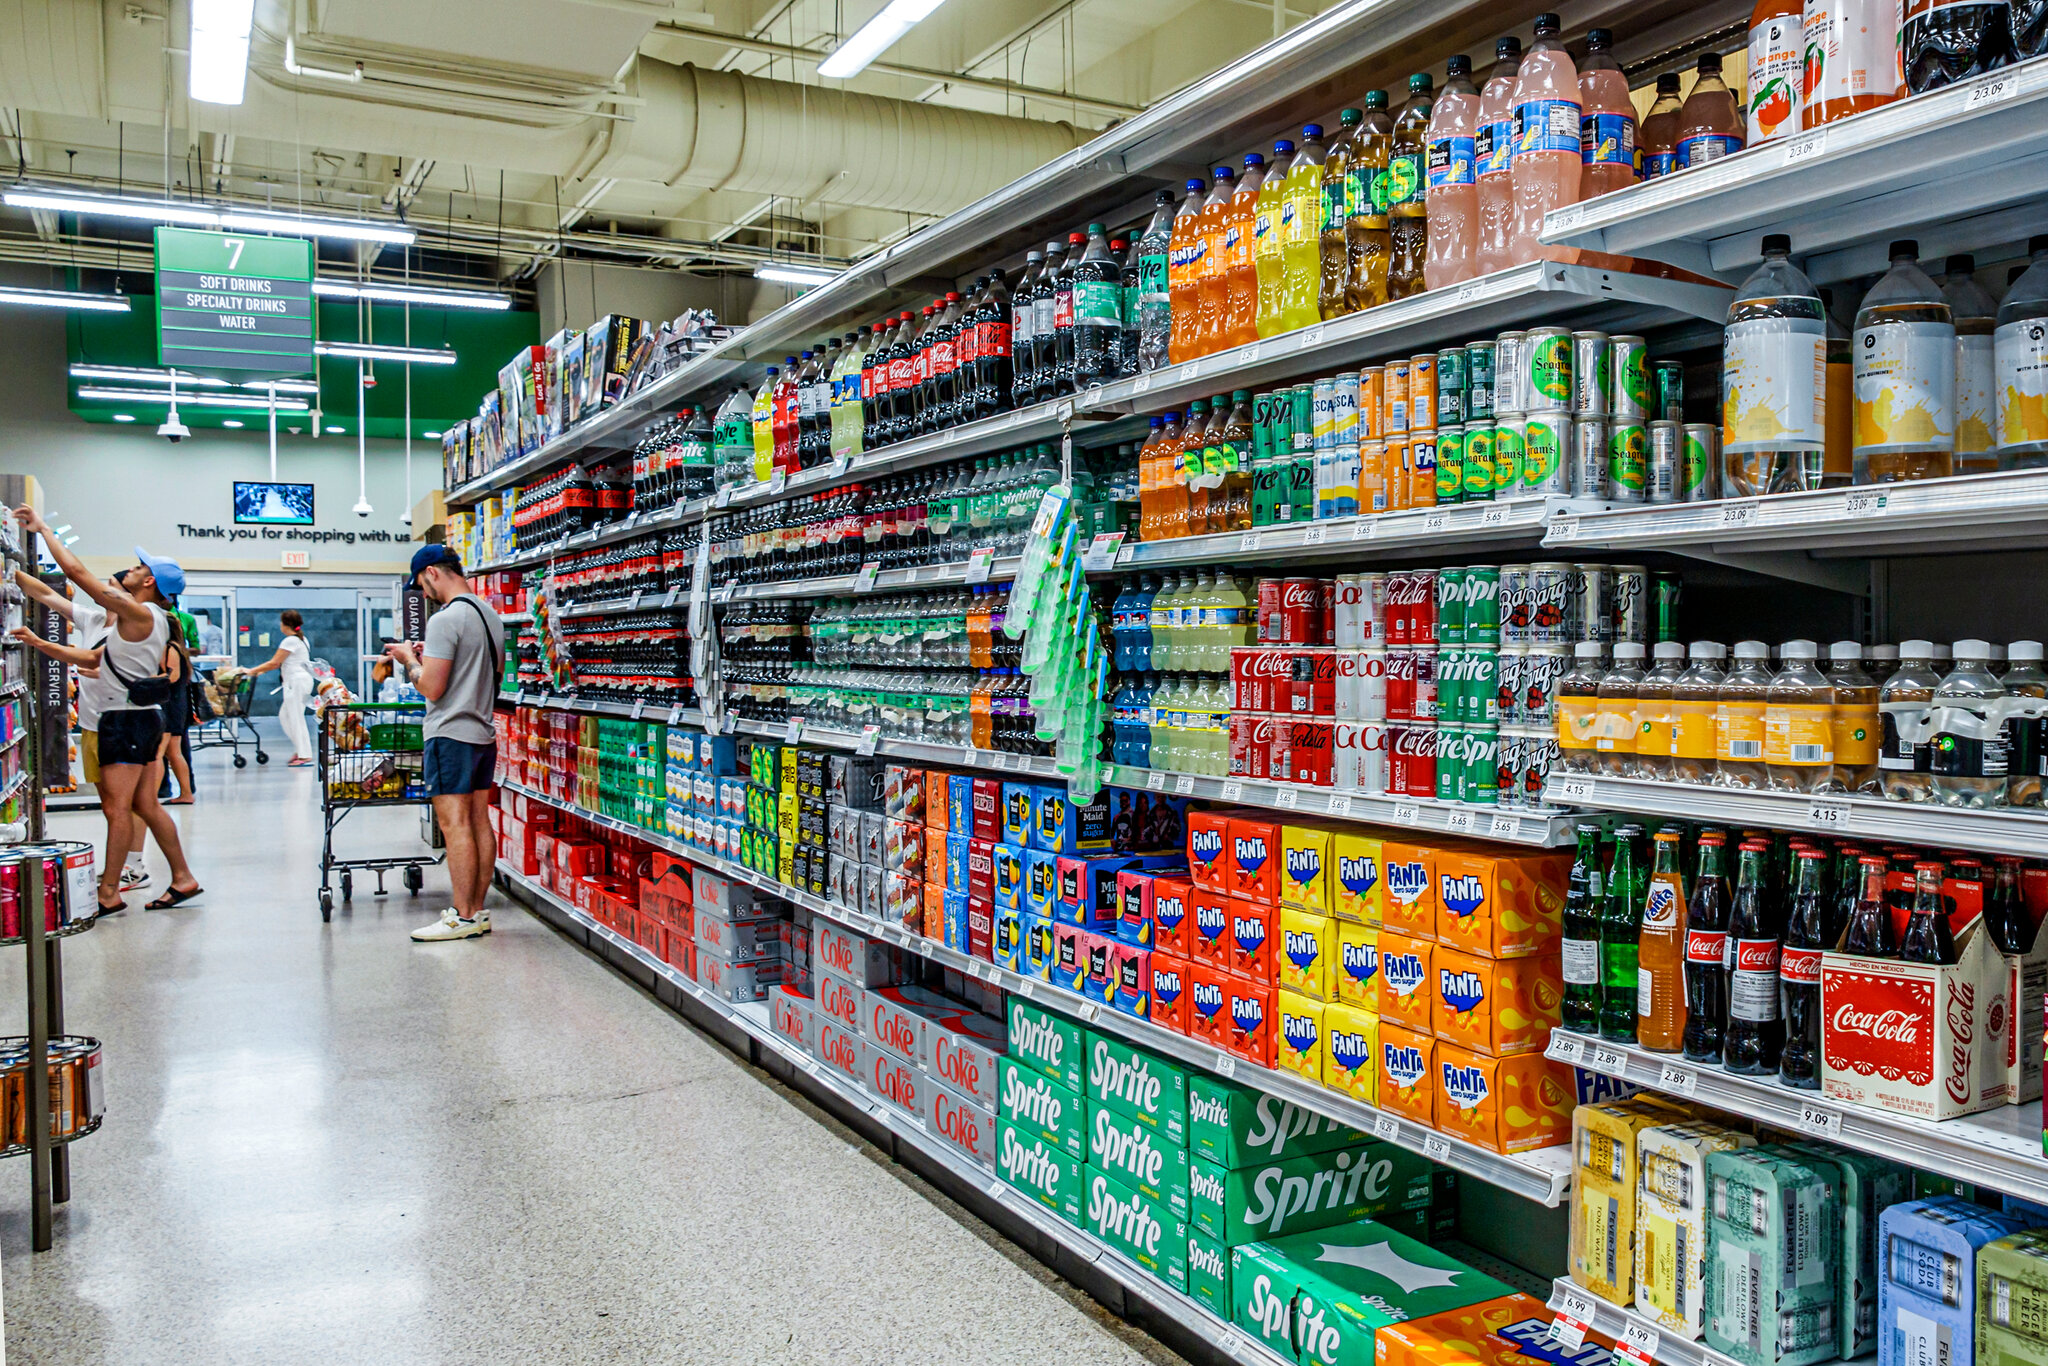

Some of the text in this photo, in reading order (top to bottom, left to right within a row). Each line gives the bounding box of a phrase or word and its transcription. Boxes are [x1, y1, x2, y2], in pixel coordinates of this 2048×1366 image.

[1804, 11, 1827, 29] range
[1757, 50, 1797, 66] orange
[1973, 82, 2004, 101] 2/3.09
[1789, 141, 1814, 159] 2/3.09
[224, 239, 245, 270] 7
[200, 275, 272, 294] SOFT DRINKS
[186, 294, 287, 313] SPECIALTY DRINKS
[219, 315, 256, 330] WATER
[1304, 332, 1317, 343] 2.29
[1241, 350, 1253, 361] 2.29
[1868, 359, 1902, 369] water
[534, 362, 542, 373] Go
[753, 409, 771, 423] ANTA
[1526, 443, 1556, 456] gram's
[1846, 499, 1868, 512] 2/3.09
[1427, 518, 1443, 528] 5.65
[1486, 512, 1502, 522] 5.65
[1724, 509, 1747, 522] 2/3.09
[177, 524, 411, 544] Thank you for shopping with us
[1307, 530, 1321, 540] 5.65
[1356, 525, 1371, 535] 5.65
[1243, 536, 1256, 546] 5.65
[286, 552, 306, 566] EXIT
[48, 659, 60, 707] SERVICE
[1178, 778, 1189, 788] 5.65
[1225, 786, 1236, 795] 5.65
[1401, 779, 1406, 792] ME
[1566, 785, 1584, 796] 4.15
[1279, 793, 1292, 803] 5.65
[1331, 800, 1345, 810] 5.65
[1083, 811, 1104, 821] Maid
[1396, 809, 1412, 819] 5.65
[1451, 815, 1467, 826] 5.65
[1813, 808, 1838, 822] 4.15
[1082, 829, 1105, 838] sugar
[1494, 821, 1511, 832] 5.65
[1192, 830, 1223, 852] FANTA
[1235, 838, 1267, 860] FANTA
[1287, 849, 1320, 871] FANTA
[1340, 857, 1378, 881] FANTA
[1387, 862, 1428, 887] FANTA
[1405, 887, 1420, 896] sugar
[1441, 874, 1484, 901] FANTA
[1125, 893, 1140, 905] Minute
[1127, 903, 1139, 913] Maid
[1156, 897, 1185, 918] FANTA
[1197, 906, 1226, 928] FANTA
[1234, 917, 1265, 940] FANTA
[820, 928, 853, 977] Coke
[1285, 931, 1319, 956] FANTA
[1343, 943, 1378, 968] FANTA
[1122, 964, 1137, 978] Minute
[1384, 953, 1424, 979] FANTA
[1849, 961, 1870, 970] HECHO
[1871, 963, 1880, 971] EN
[1124, 974, 1136, 986] Maid
[1154, 970, 1182, 993] FANTA
[1390, 977, 1417, 987] zero sugar
[1440, 969, 1484, 998] FANTA
[821, 977, 856, 1025] Coke
[1193, 982, 1223, 1006] FANTA
[1232, 996, 1263, 1021] FANTA
[874, 1004, 914, 1057] Coke
[1283, 1014, 1318, 1040] FANTA
[1833, 1002, 1923, 1044] Coca-Cola
[1010, 1003, 1063, 1066] Sprite
[1945, 974, 1975, 1105] Coca-Cola
[821, 1025, 855, 1076] Coke
[963, 1045, 976, 1063] Diet
[1331, 1030, 1369, 1060] FANTA
[1556, 1039, 1574, 1053] 2.89
[936, 1036, 979, 1095] Coke
[1384, 1044, 1425, 1072] FANTA
[1598, 1051, 1617, 1065] 2.89
[875, 1056, 915, 1111] Coke
[1090, 1040, 1161, 1113] Sprite
[1174, 1075, 1182, 1085] 12
[1391, 1069, 1417, 1080] zero sugar
[1442, 1063, 1488, 1094] FANTA
[1664, 1070, 1686, 1085] 2.89
[1003, 1065, 1062, 1132] Sprite
[1450, 1090, 1479, 1101] zero sugar
[963, 1104, 976, 1121] Diet
[1189, 1090, 1229, 1127] Sprite
[935, 1093, 978, 1154] Coke
[1378, 1121, 1393, 1133] 10.29
[1805, 1110, 1829, 1126] 9.09
[1091, 1108, 1163, 1186] Sprite
[1177, 1150, 1185, 1160] 12
[1428, 1140, 1443, 1152] 10.29
[1000, 1127, 1060, 1196] Sprite
[1190, 1165, 1225, 1206] Sprite
[1243, 1151, 1393, 1233] Sprite
[1088, 1176, 1162, 1256] Sprite
[1175, 1223, 1185, 1233] 12
[1608, 1210, 1616, 1274] FEVER-TREE
[1785, 1202, 1795, 1274] FEVER-TREE
[1188, 1238, 1225, 1281] Sprite
[1231, 1250, 1241, 1263] 24
[1677, 1238, 1685, 1307] FEVER-TREE
[1918, 1251, 1927, 1286] SODA
[1926, 1255, 1935, 1289] CLUB
[1360, 1294, 1409, 1321] Sprite
[1567, 1298, 1586, 1312] 6.99
[1751, 1267, 1759, 1339] FEVER-TREE
[2020, 1296, 2030, 1328] BEER
[1565, 1317, 1579, 1327] save
[2031, 1288, 2041, 1338] GINGER
[1628, 1327, 1649, 1342] 6.99
[1627, 1346, 1641, 1357] save
